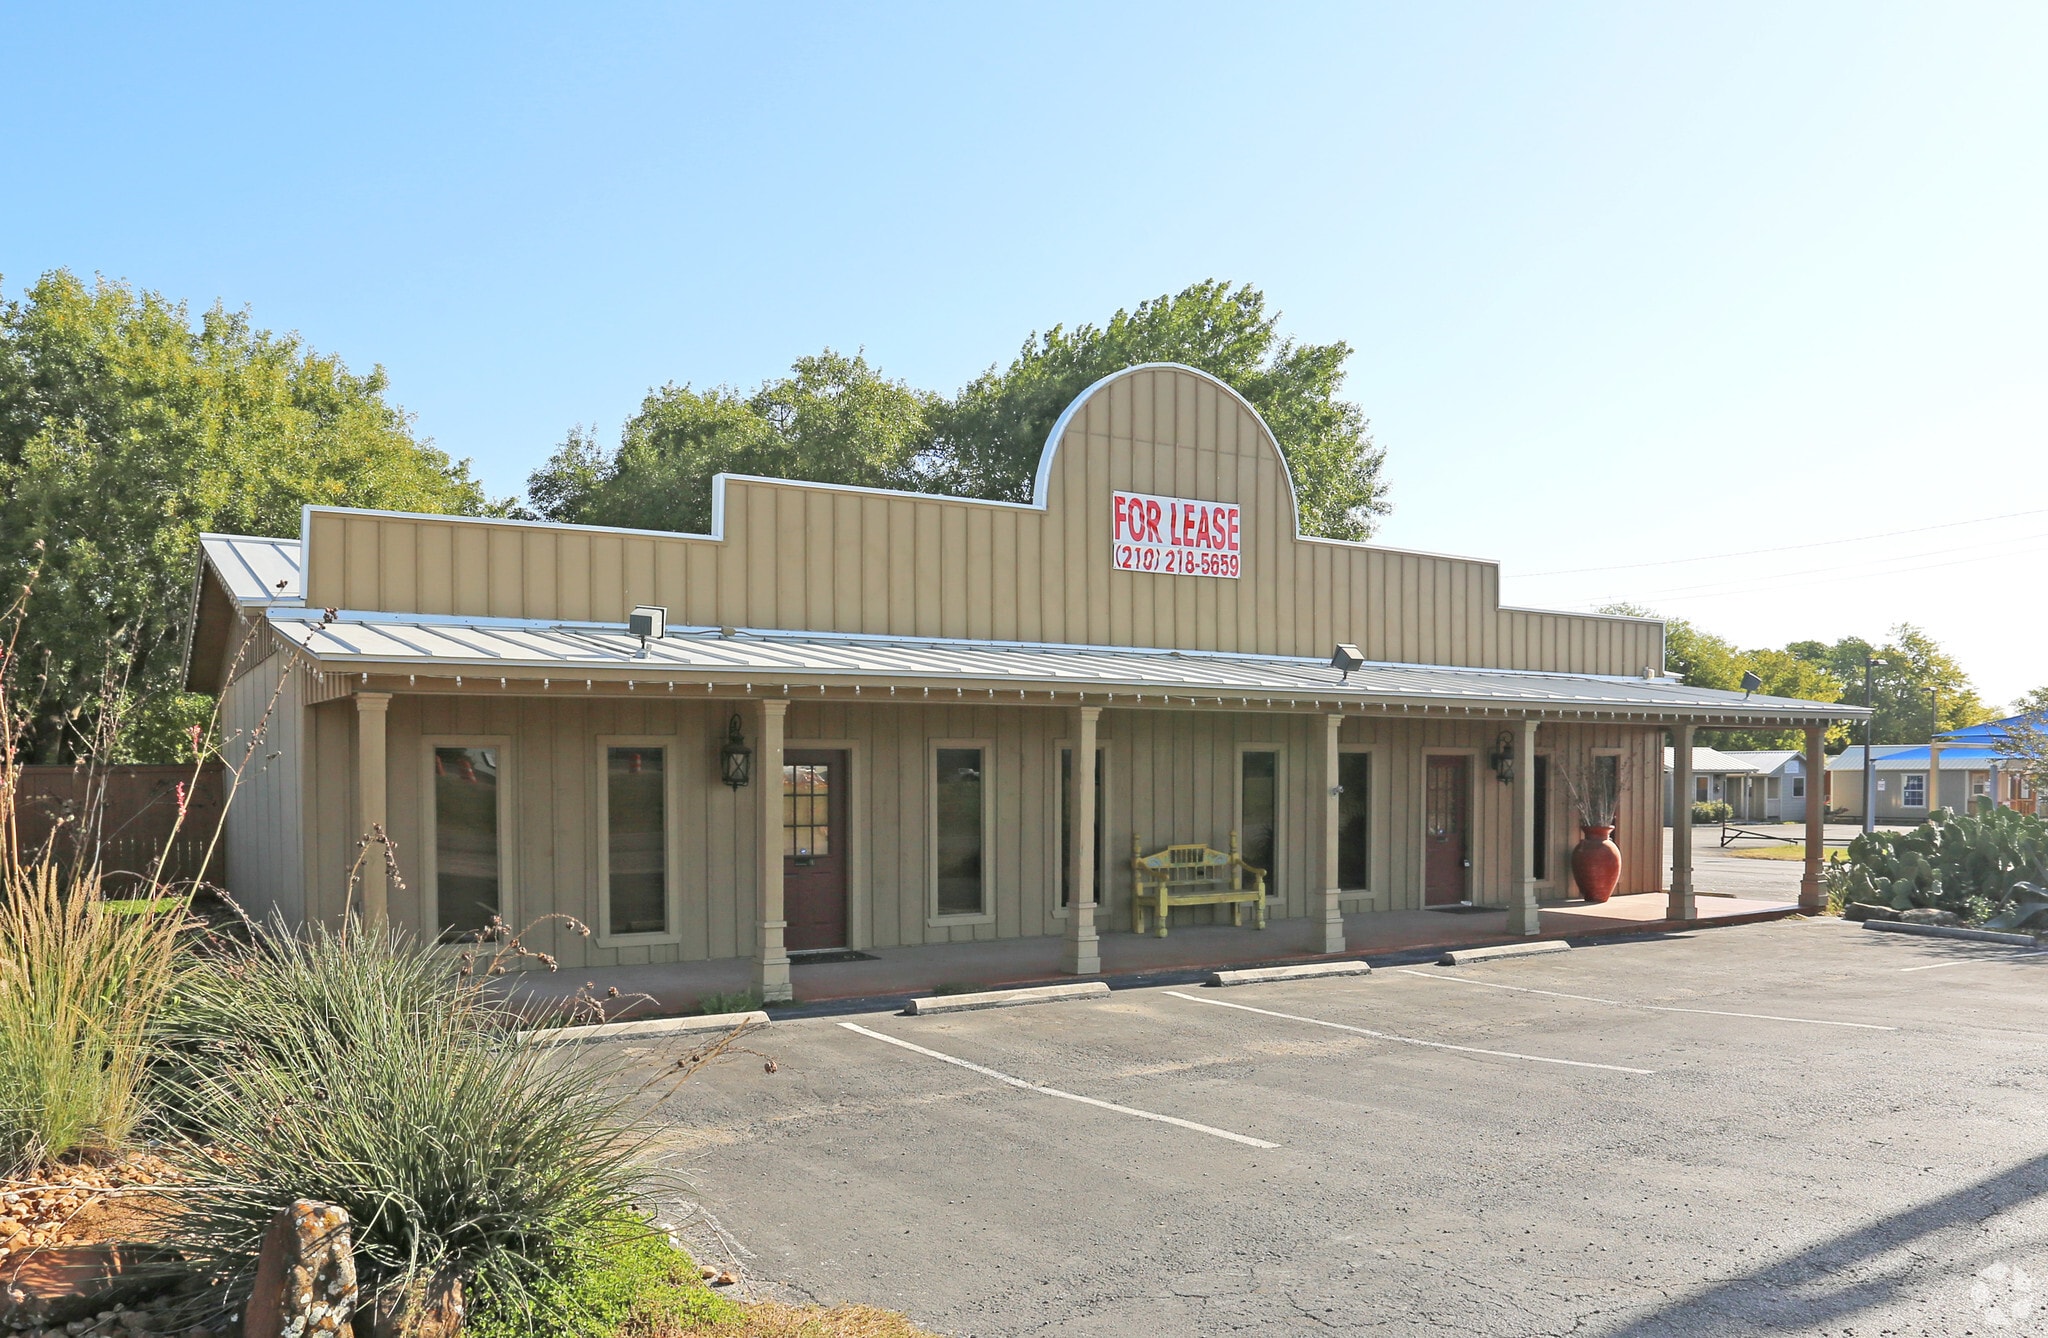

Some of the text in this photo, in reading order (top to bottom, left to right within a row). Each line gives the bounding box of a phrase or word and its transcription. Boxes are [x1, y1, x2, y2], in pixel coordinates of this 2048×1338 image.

[1114, 495, 1239, 551] FOR LEASE
[1115, 544, 1239, 577] (210) 218-5659
